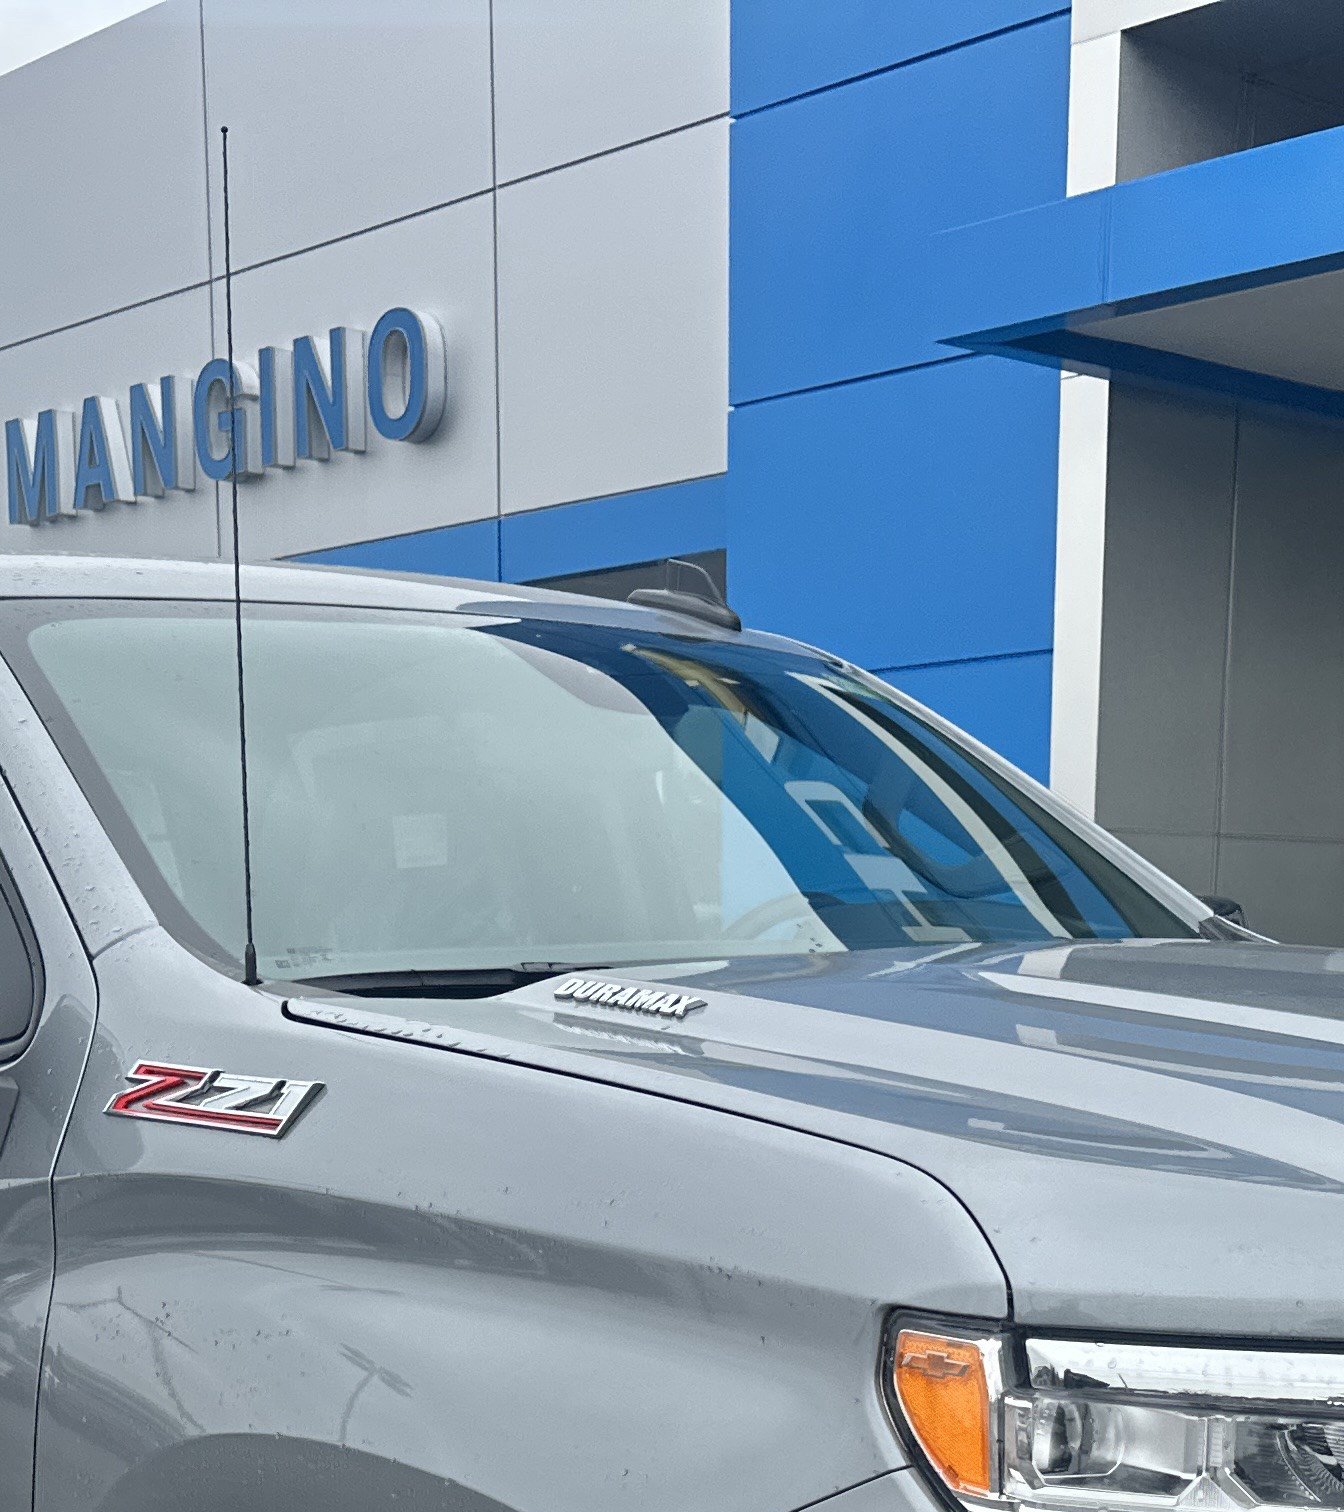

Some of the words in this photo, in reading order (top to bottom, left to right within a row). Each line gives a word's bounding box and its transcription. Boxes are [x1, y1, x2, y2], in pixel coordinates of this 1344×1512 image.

[5, 306, 444, 526] MANGINO
[554, 978, 704, 1018] DURAMAX
[103, 1059, 325, 1138] Z71
